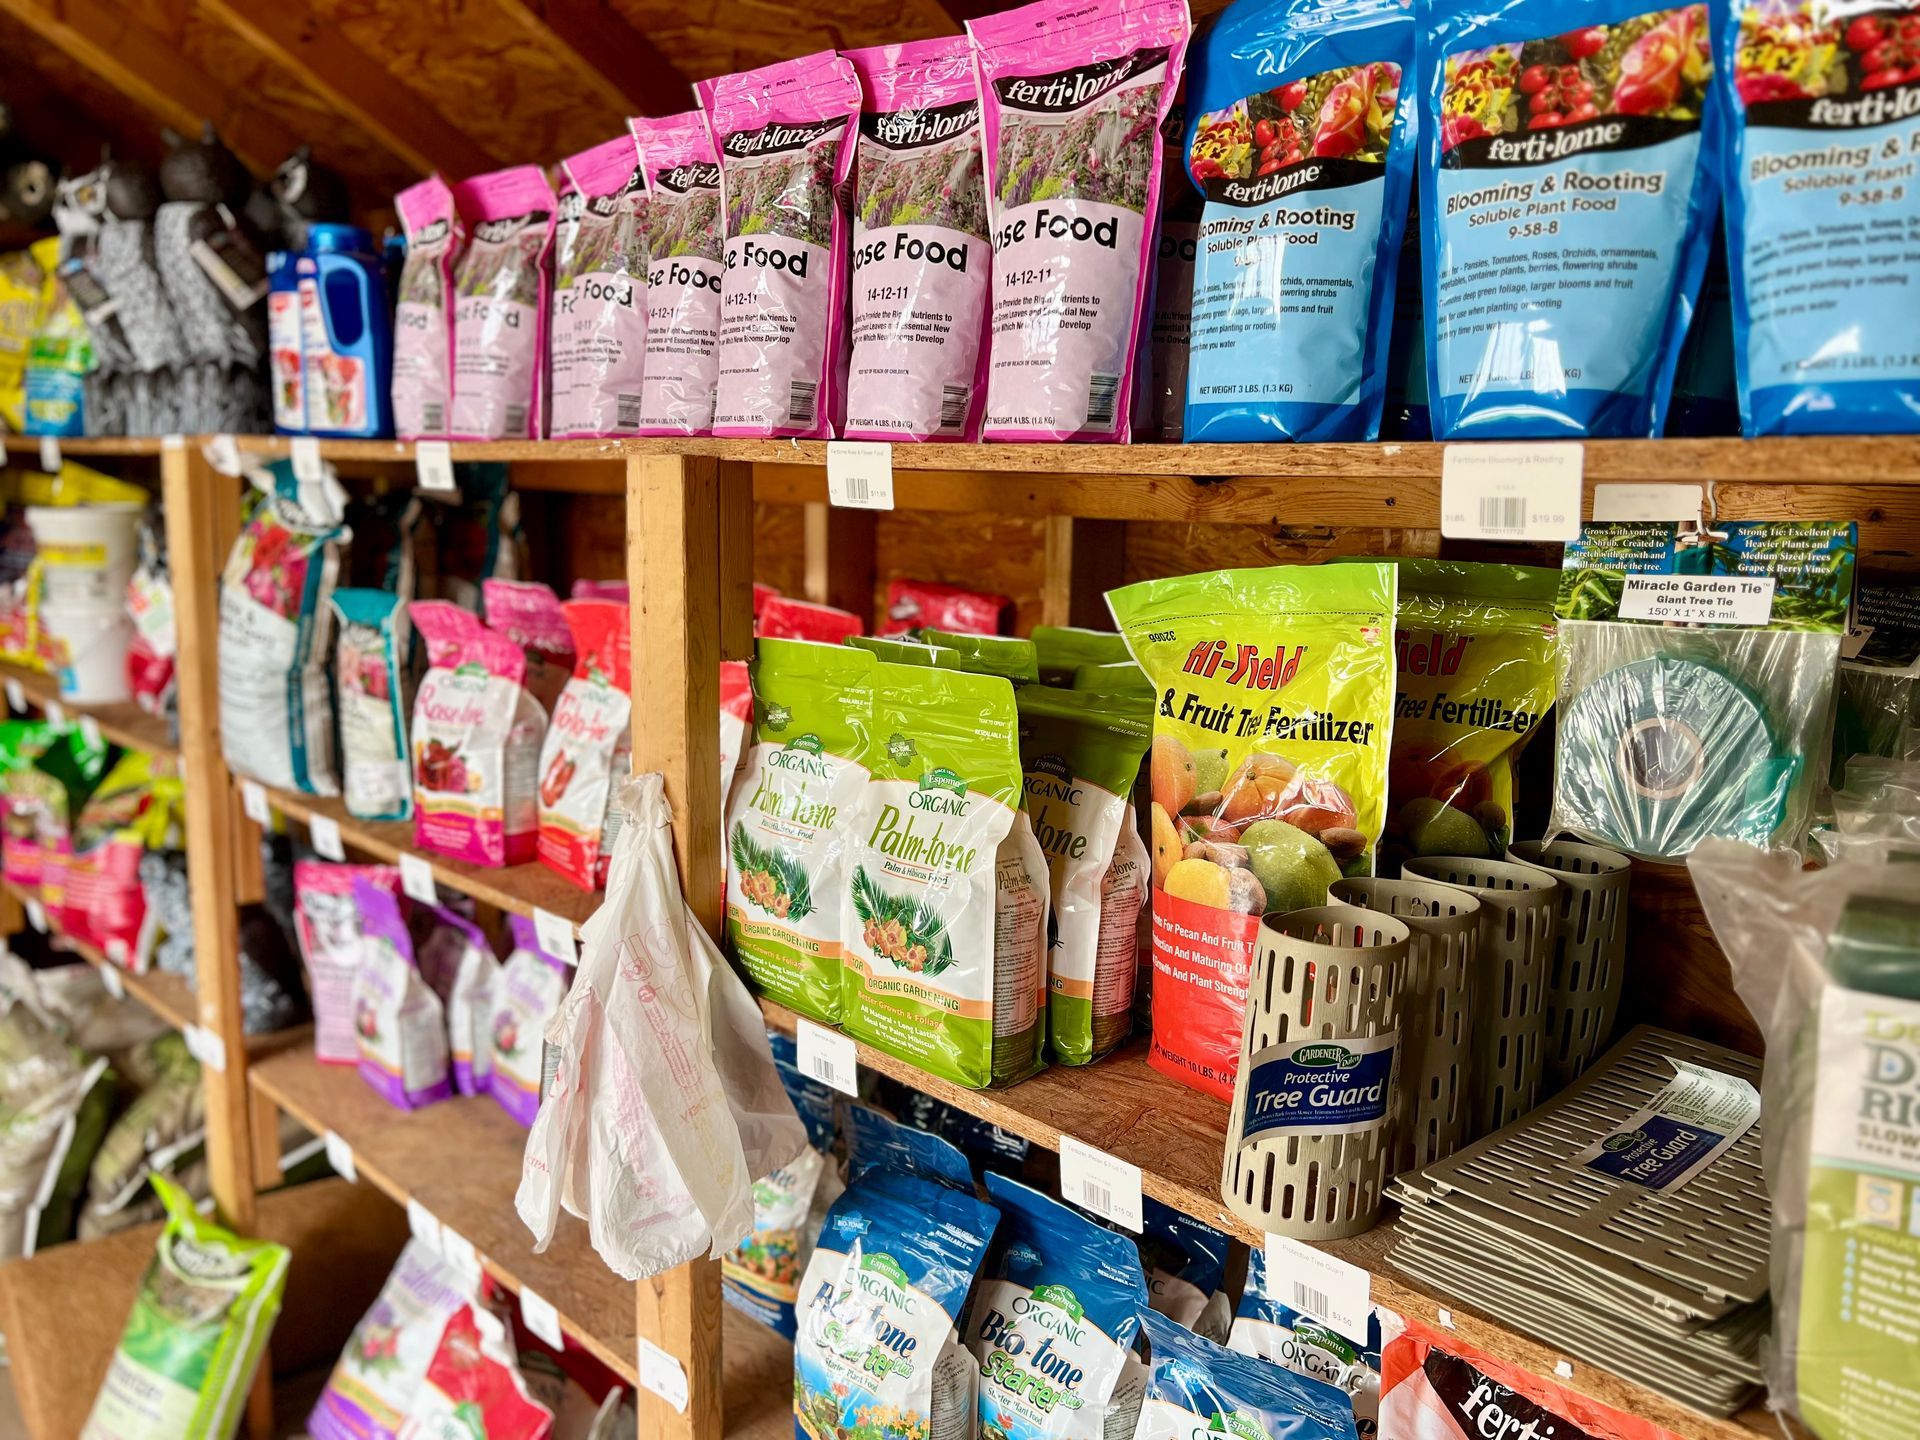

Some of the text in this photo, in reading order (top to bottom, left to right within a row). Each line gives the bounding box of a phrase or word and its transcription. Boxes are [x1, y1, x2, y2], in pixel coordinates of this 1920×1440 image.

[1447, 171, 1664, 216] Blooming & Rooting
[1258, 212, 1270, 229] &
[1275, 207, 1356, 231] Rooting
[1468, 197, 1617, 228] Soluble Plant Food
[1034, 208, 1119, 250] Food
[1508, 220, 1558, 240] 9-58-8
[894, 232, 968, 273] Food
[1207, 240, 1243, 254] Soluble
[743, 241, 809, 279] Food
[1463, 247, 1659, 272] Pansies, Tomatoes, Roses, Orchids, ornamentals,
[669, 262, 722, 294] Foo
[1500, 259, 1639, 280] plants, berries, flowering shrubs
[1306, 277, 1354, 289] ornamentals,
[1477, 277, 1634, 299] green foliage, larger blooms and fruit
[868, 286, 909, 301] 14-12-11
[1311, 288, 1337, 298] shrubs
[911, 310, 943, 321] Nutrients
[1079, 307, 1098, 318] New
[1301, 304, 1334, 314] and fruit
[1467, 299, 1563, 318] when planting rooting
[934, 323, 951, 334] New
[1059, 319, 1091, 331] Develop
[1220, 321, 1277, 334] planting rooting
[916, 333, 945, 345] Develop
[1220, 339, 1236, 349] water
[1212, 384, 1294, 395] WEIGHT 3 KG)
[1532, 513, 1566, 524] $19.99
[1584, 527, 1669, 539] Grows with your Tree
[1738, 528, 1850, 539] Strong Tie: Excellent For
[1623, 538, 1665, 548] Created to
[1745, 539, 1829, 549] Heavier Plants and
[1572, 549, 1667, 562] stretch with growth and
[1740, 551, 1831, 562] Medium Sized Trees
[1591, 561, 1663, 572] not girdle the tree.
[1737, 563, 1831, 575] Grape & Berry Vines
[1627, 579, 1680, 592] Miracle
[1683, 580, 1737, 594] Garden
[1656, 595, 1734, 607] Giant Tree Tie
[1674, 608, 1739, 620] X X 8 mil.
[1182, 639, 1305, 691] Hi-Yield
[1158, 687, 1375, 746] & Fruit Fertilizer
[1428, 692, 1539, 734] Fertilizer
[1034, 759, 1067, 774] Espoma
[928, 774, 961, 789] Espoma
[908, 791, 972, 817] ORGANIC
[867, 803, 978, 874] Palm-tone
[883, 860, 927, 882] Palm Hibiscus
[744, 923, 819, 952] ORGANIC GARDENING
[1162, 918, 1174, 933] For
[1174, 923, 1200, 942] Pecan
[1201, 931, 1220, 947] And
[1221, 936, 1245, 954] Fruit
[1174, 945, 1233, 974] And Maturing
[1172, 966, 1249, 1001] And Plant Strengt
[868, 977, 960, 1011] ORGANIC GARDENING
[869, 1006, 914, 1035] Natural Long
[879, 1000, 945, 1031] Growth Foliage
[908, 1033, 936, 1050] Hibiscus
[1160, 1046, 1217, 1081] WEIGHT 10 LBS.
[1283, 1069, 1351, 1085] Protective
[1254, 1078, 1384, 1116] Tree Guard
[1620, 1156, 1664, 1181] Tree
[1657, 1127, 1699, 1161] Guard
[1113, 1204, 1135, 1219] $15.00
[869, 1256, 902, 1280] Espoma
[1042, 1288, 1077, 1312] Espoma
[1012, 1297, 1087, 1347] ORGANIC
[979, 1309, 1084, 1390] Bio-tone
[980, 1350, 1061, 1414] Starter
[1029, 1409, 1044, 1427] Food
